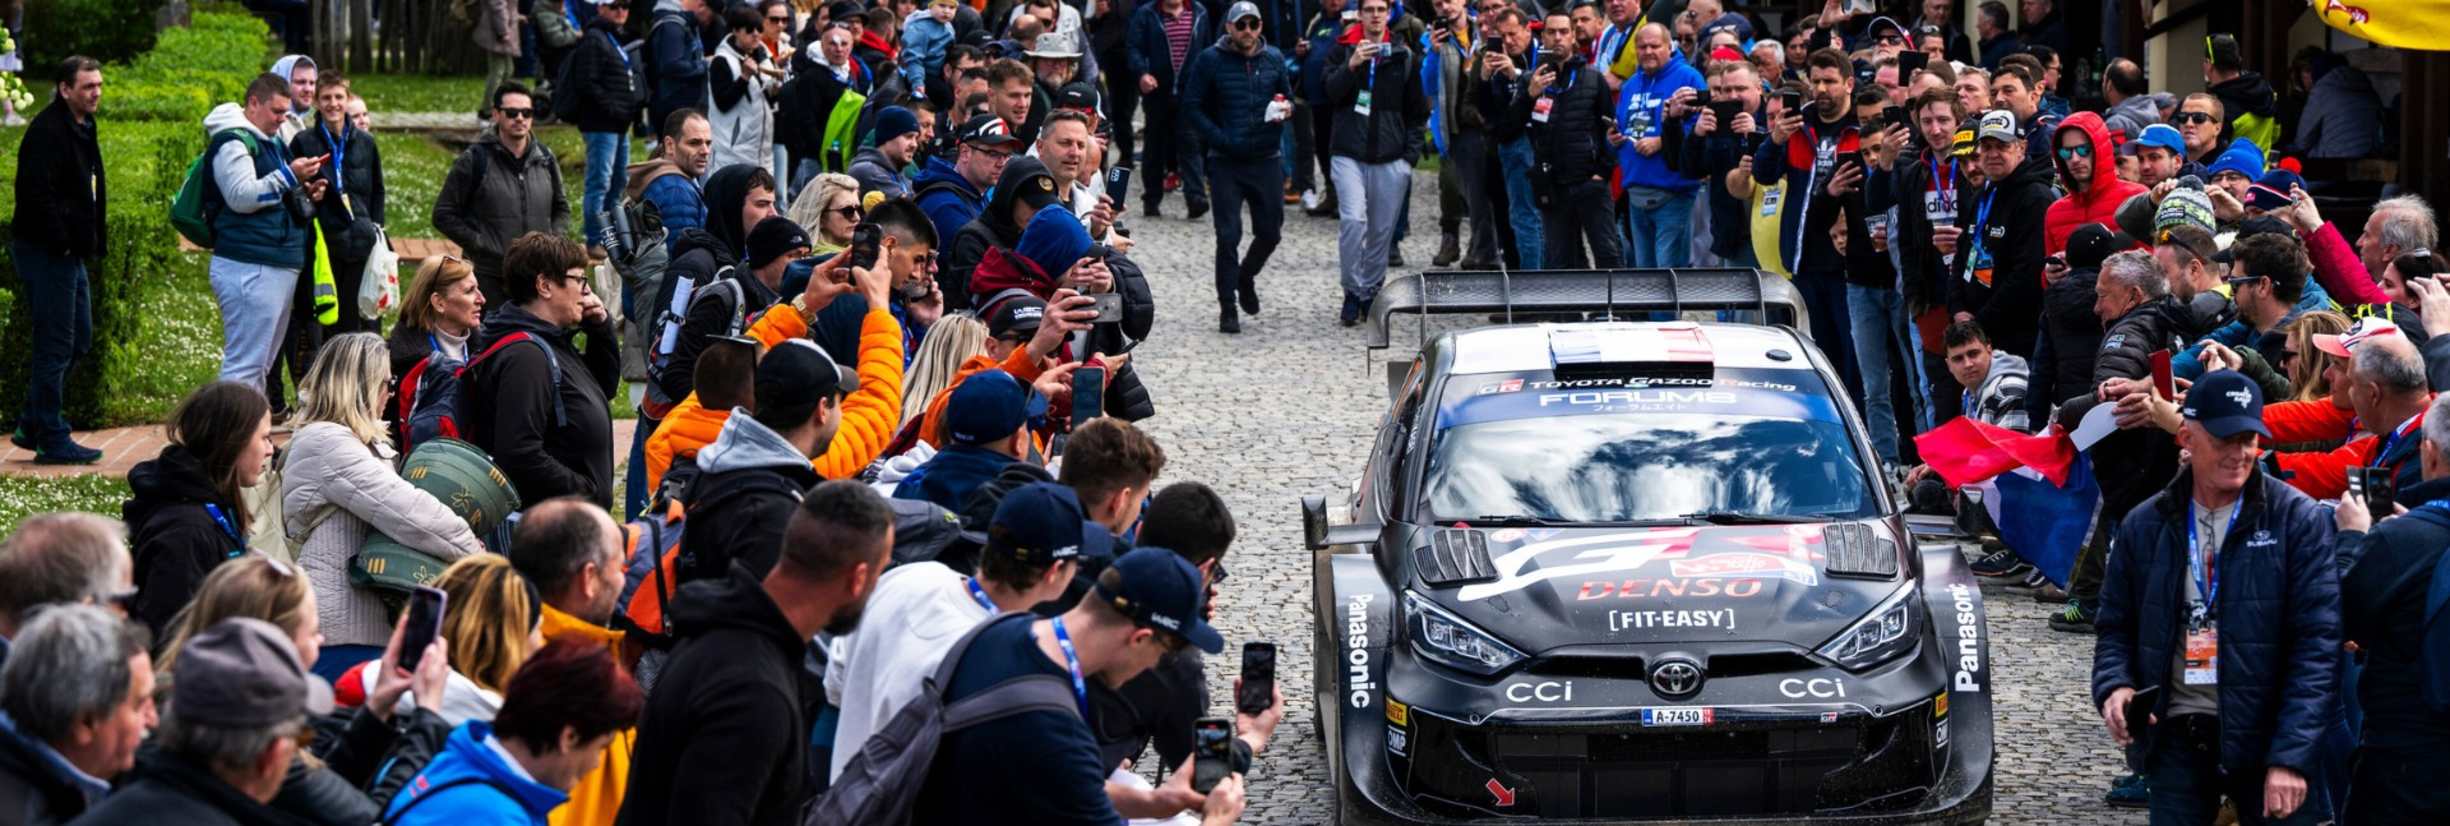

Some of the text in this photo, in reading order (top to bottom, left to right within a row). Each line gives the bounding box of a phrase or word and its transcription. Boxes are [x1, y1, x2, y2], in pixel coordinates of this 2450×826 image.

[1530, 376, 1797, 392] TOYOTA GAZOO Racing
[1538, 390, 1738, 407] FORUM8
[2246, 538, 2278, 548] SUBARU
[1576, 577, 1763, 601] DENSO
[1608, 608, 1736, 632] [FIT-EASY]
[1944, 583, 1980, 692] Panasonic
[1348, 594, 1376, 709] Panasonic
[1505, 681, 1572, 702] CCi
[1779, 678, 1846, 699] CCi
[1656, 710, 1700, 723] A-7450
[1387, 731, 1407, 751] OMP
